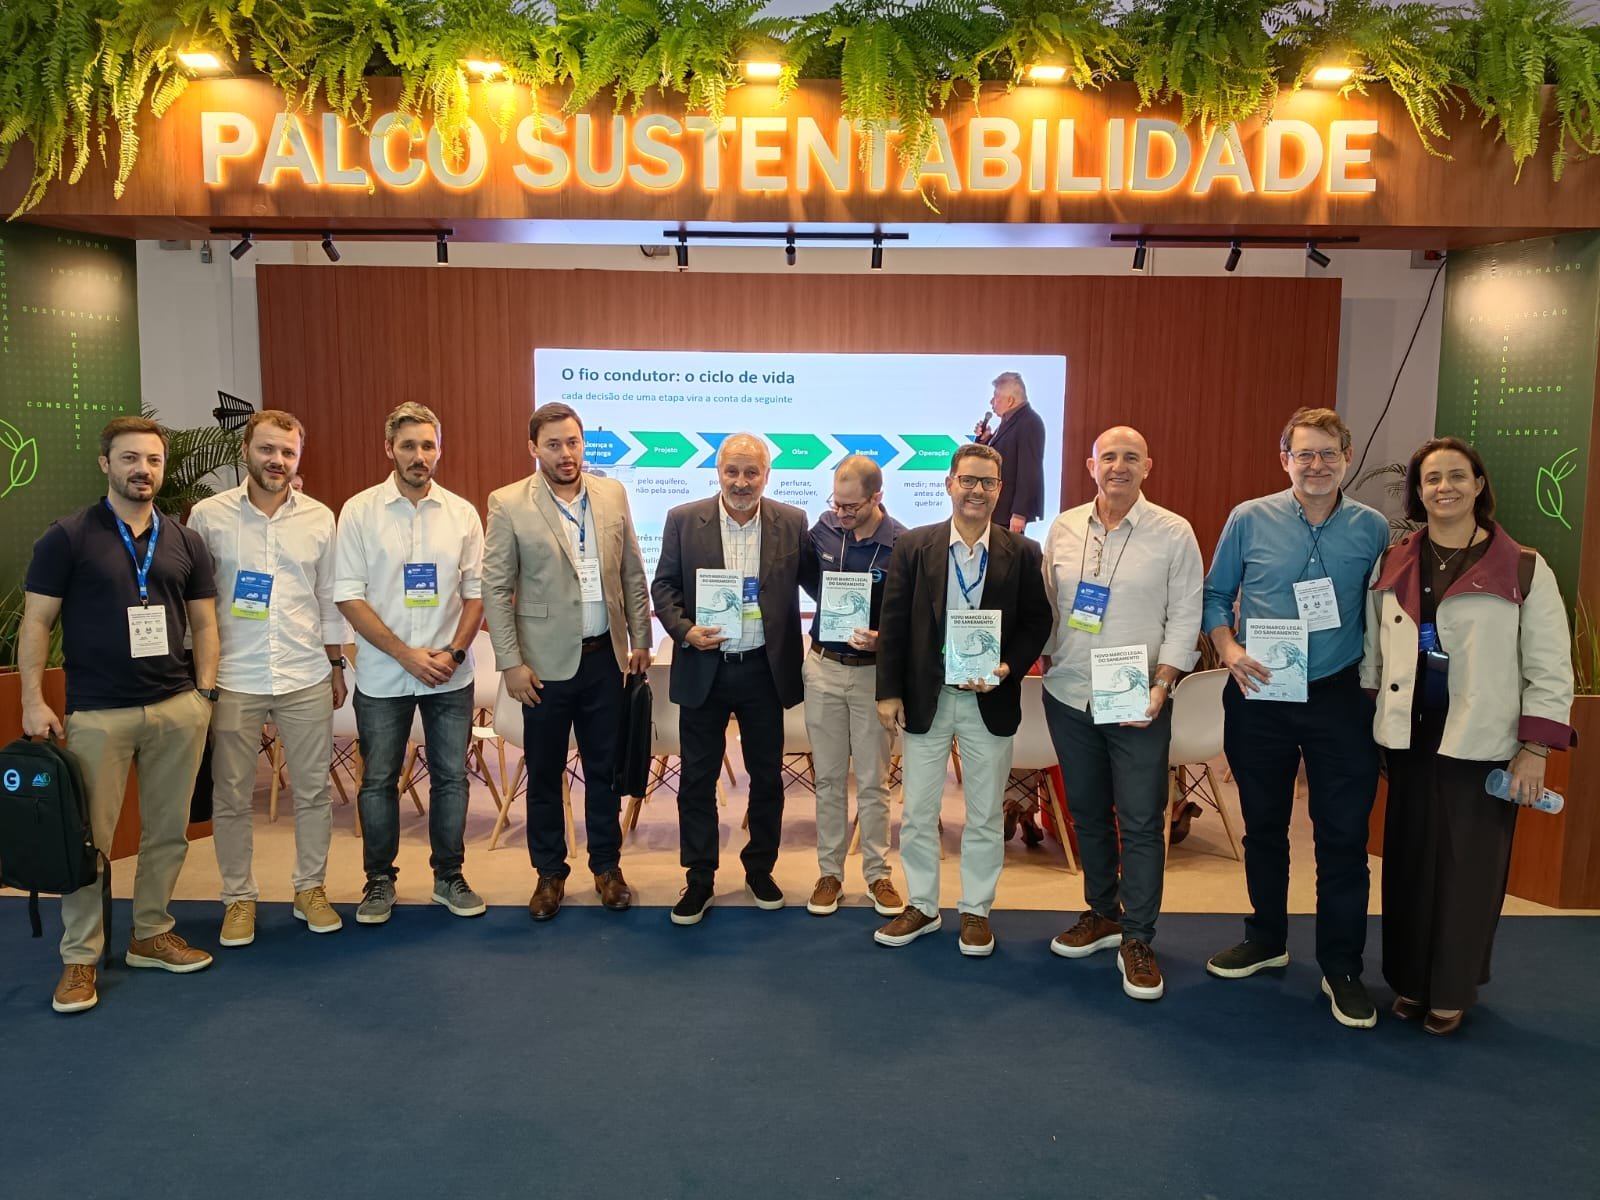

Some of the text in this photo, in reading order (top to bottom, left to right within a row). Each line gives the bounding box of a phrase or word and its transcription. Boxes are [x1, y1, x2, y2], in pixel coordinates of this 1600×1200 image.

[200, 111, 1377, 193] PALCO SUSTENTABILIDADE
[561, 367, 795, 384] O fio condutor: o ciclo de vida
[561, 392, 583, 400] cada
[586, 392, 620, 401] decisão
[622, 393, 634, 401] de
[658, 394, 684, 403] etapa
[686, 394, 703, 402] vira
[713, 394, 738, 403] conta
[741, 394, 752, 403] da
[754, 394, 793, 405] seguinte
[27, 401, 124, 411] CONSCIÊNCIA
[654, 446, 678, 454] Projeto
[918, 449, 950, 457] Operação
[637, 478, 653, 486] pelo
